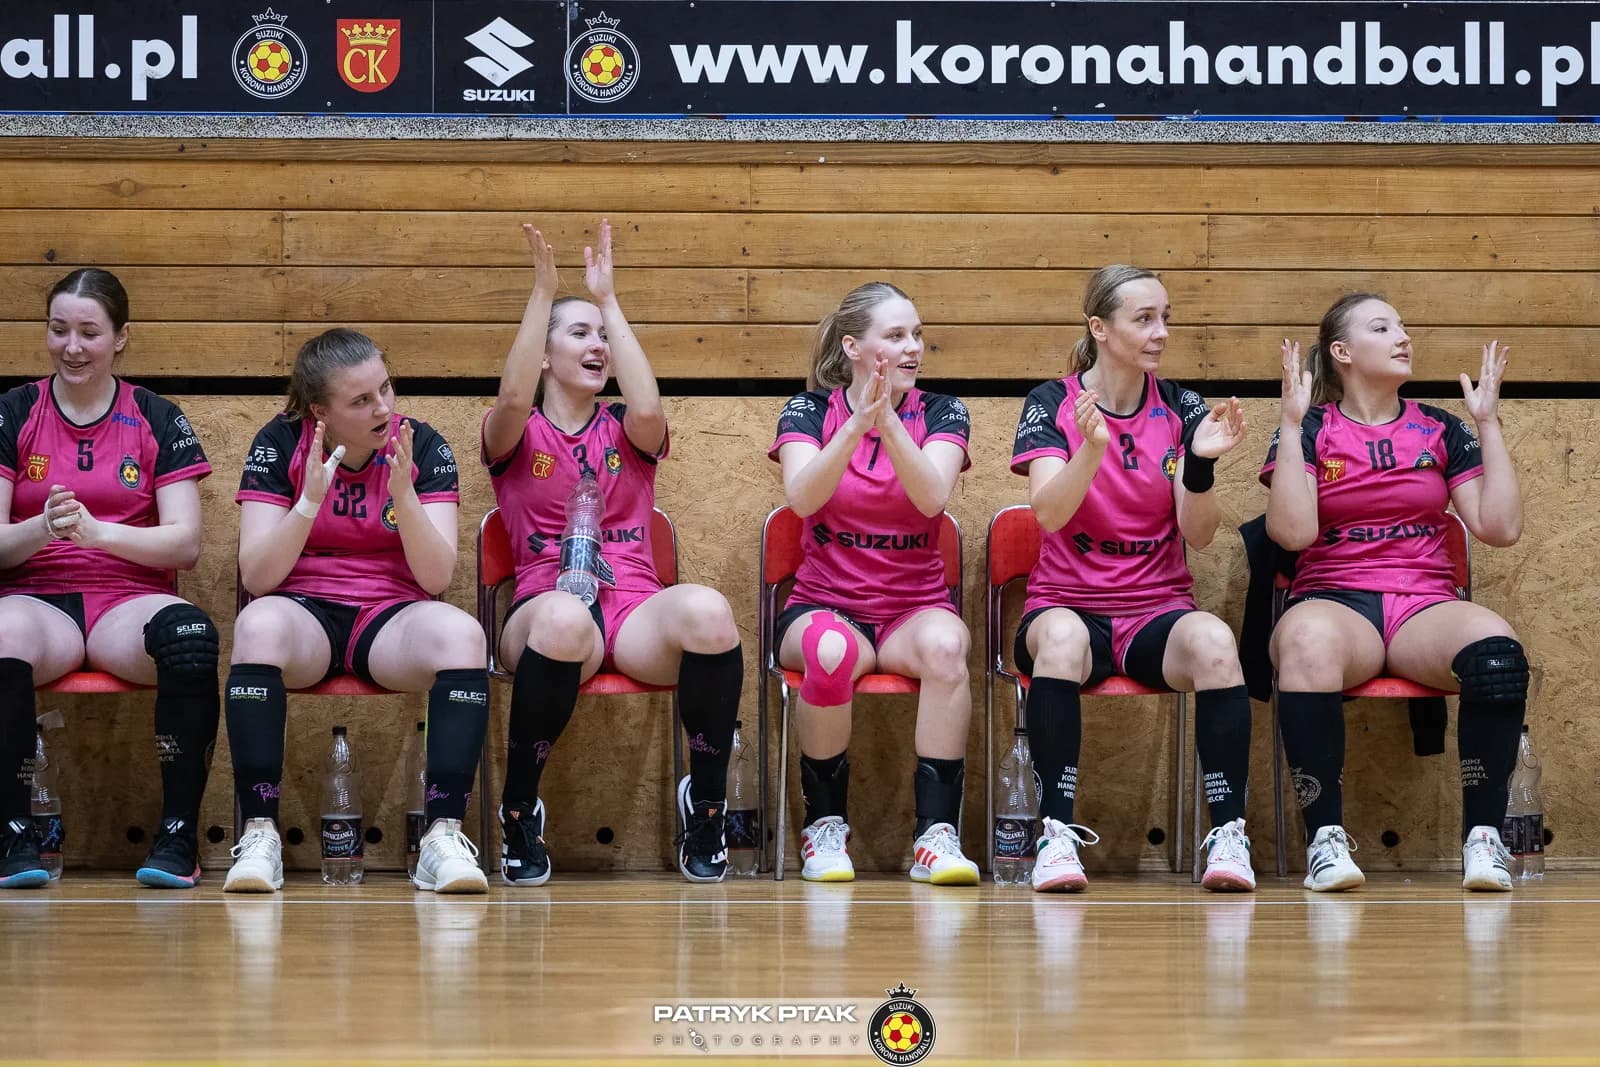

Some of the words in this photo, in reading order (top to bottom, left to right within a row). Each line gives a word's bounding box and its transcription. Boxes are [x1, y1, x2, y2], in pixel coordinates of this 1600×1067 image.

[255, 29, 285, 40] SUZUKI
[588, 33, 617, 44] SUZUKI
[343, 47, 388, 84] CK
[669, 20, 1600, 107] www.koronahandball.pl
[239, 66, 266, 93] KORONA
[266, 66, 301, 93] HANDBALL
[573, 70, 599, 97] KORONA
[599, 70, 634, 97] HANDBALL
[463, 89, 535, 102] SUZUKI
[77, 439, 94, 472] 5
[572, 443, 593, 475] 3
[868, 436, 881, 472] 7
[1119, 432, 1139, 471] 2
[1365, 438, 1397, 471] 18
[28, 464, 44, 481] CK
[532, 461, 551, 479] CK
[1324, 467, 1341, 482] CK
[332, 478, 367, 518] 32
[836, 532, 929, 550] SUZUKI
[176, 623, 206, 633] SELECT
[230, 686, 268, 697] SELECT
[449, 690, 487, 702] SELECT
